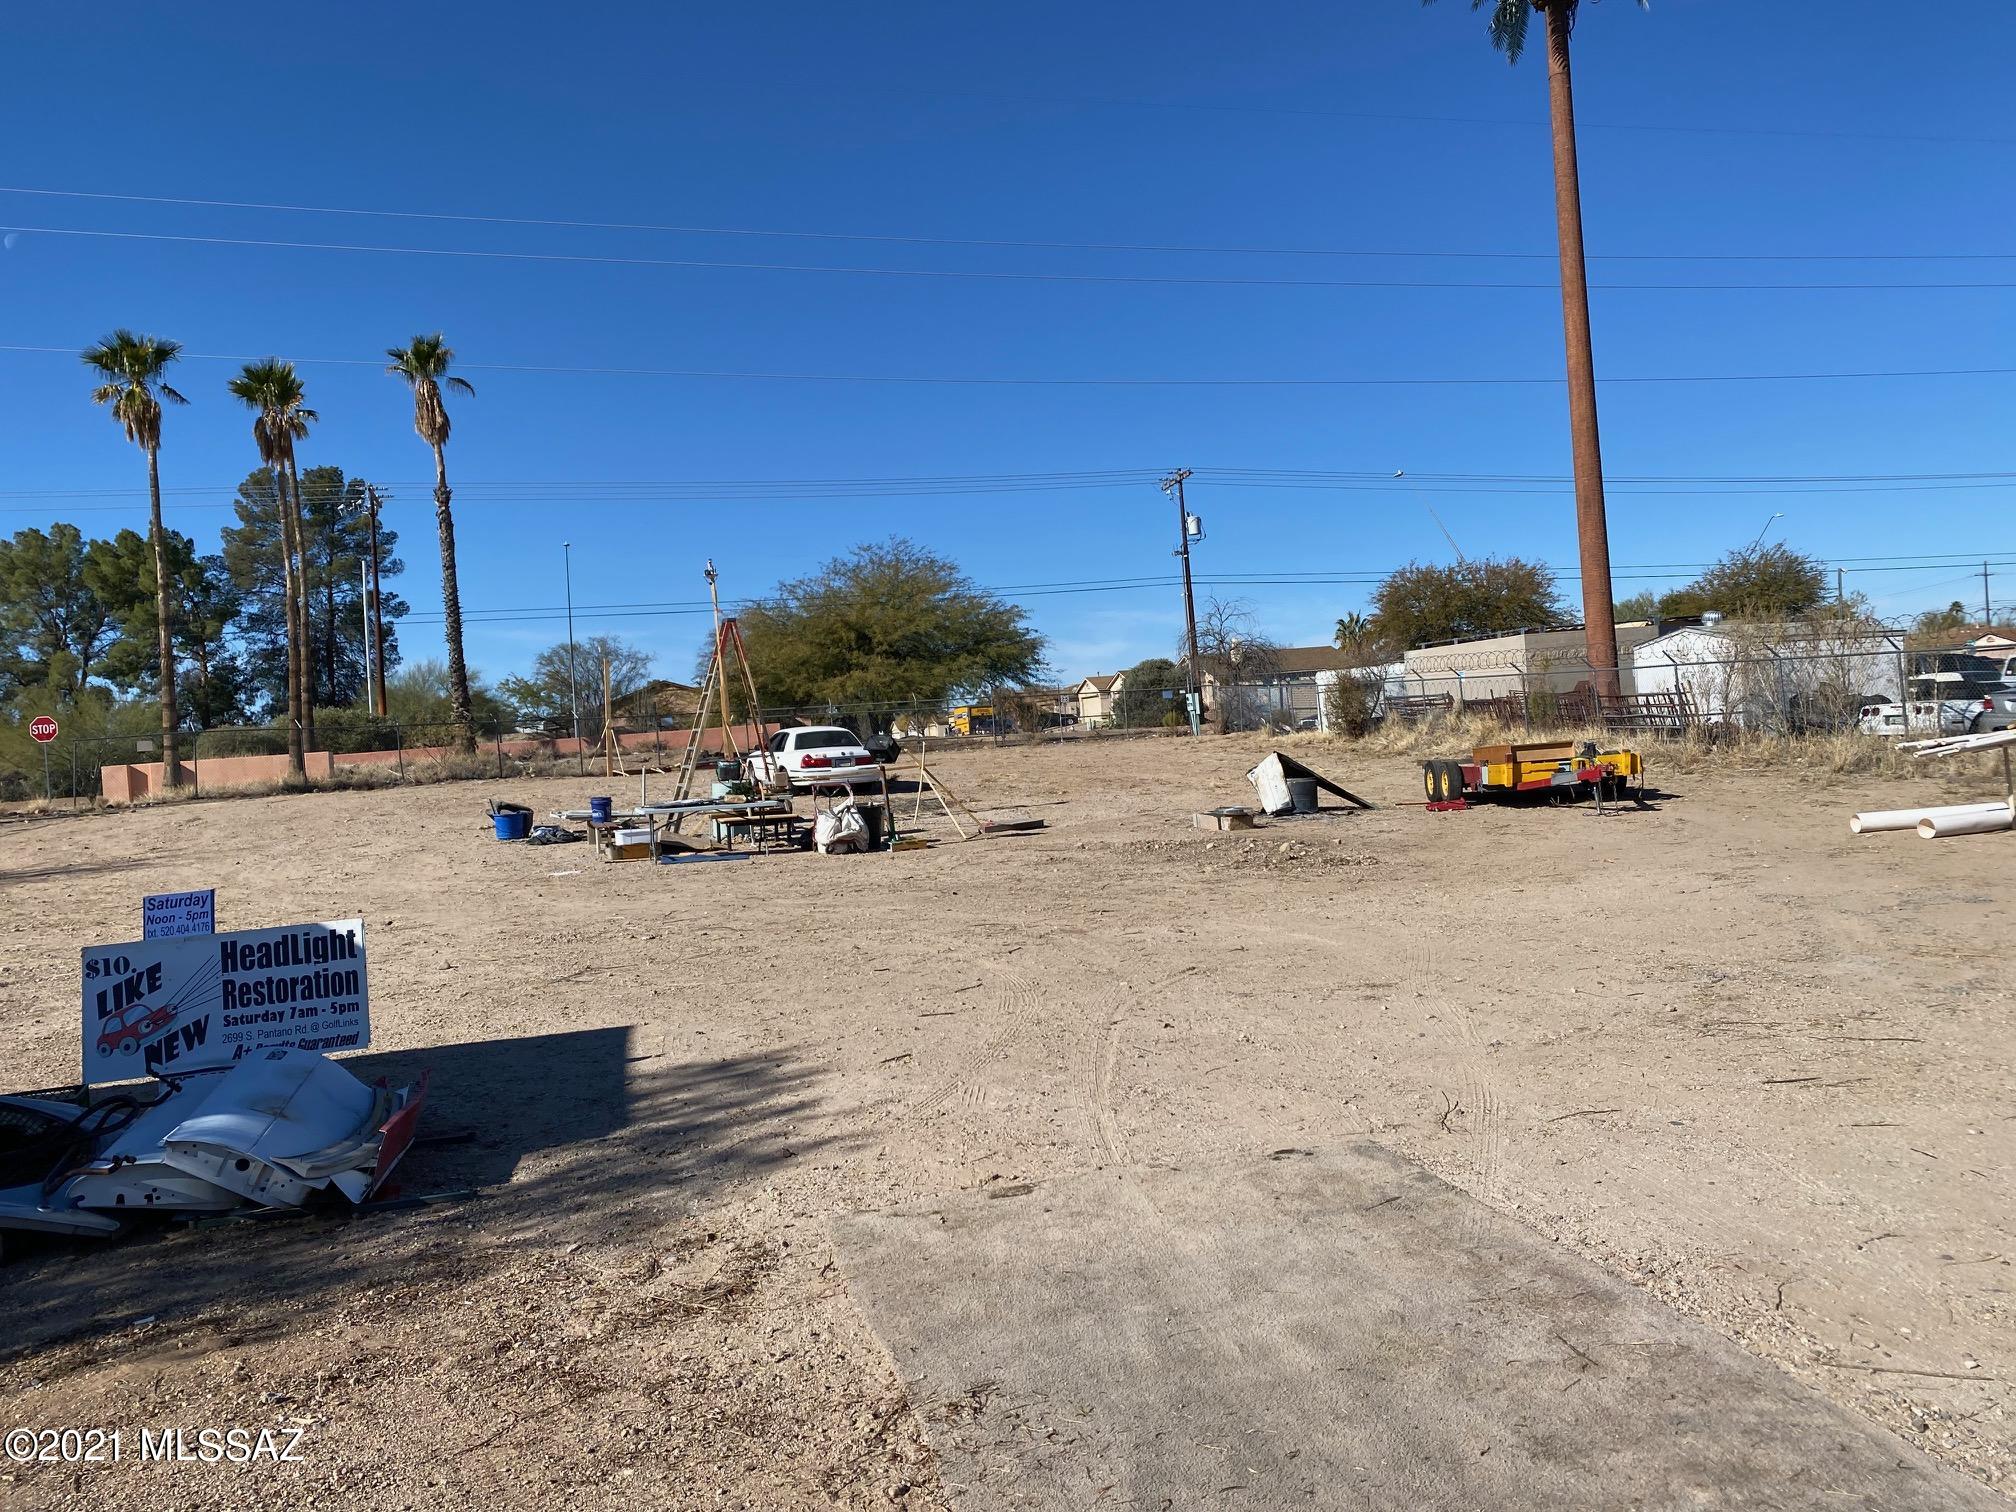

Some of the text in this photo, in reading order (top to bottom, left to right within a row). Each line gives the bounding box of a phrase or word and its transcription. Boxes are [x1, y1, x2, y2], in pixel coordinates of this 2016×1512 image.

[32, 723, 56, 735] STOP
[147, 893, 209, 911] Saturday
[146, 914, 176, 926] Noon
[185, 910, 209, 923] 5pm
[160, 921, 210, 937] 520.404.4176
[220, 929, 358, 974] HeadLight
[96, 961, 162, 1020] LIKE
[222, 968, 359, 1011] Restoration
[223, 1009, 285, 1028] Saturday
[289, 1005, 318, 1020] 7am
[330, 1001, 360, 1015] 5pm
[144, 1014, 210, 1066] NEW
[222, 1031, 244, 1044] 2699
[245, 1031, 255, 1041] S.
[257, 1026, 293, 1039] Pantano
[310, 1022, 320, 1033] @
[231, 1043, 253, 1061] A+
[297, 1031, 360, 1051] Guaranteed
